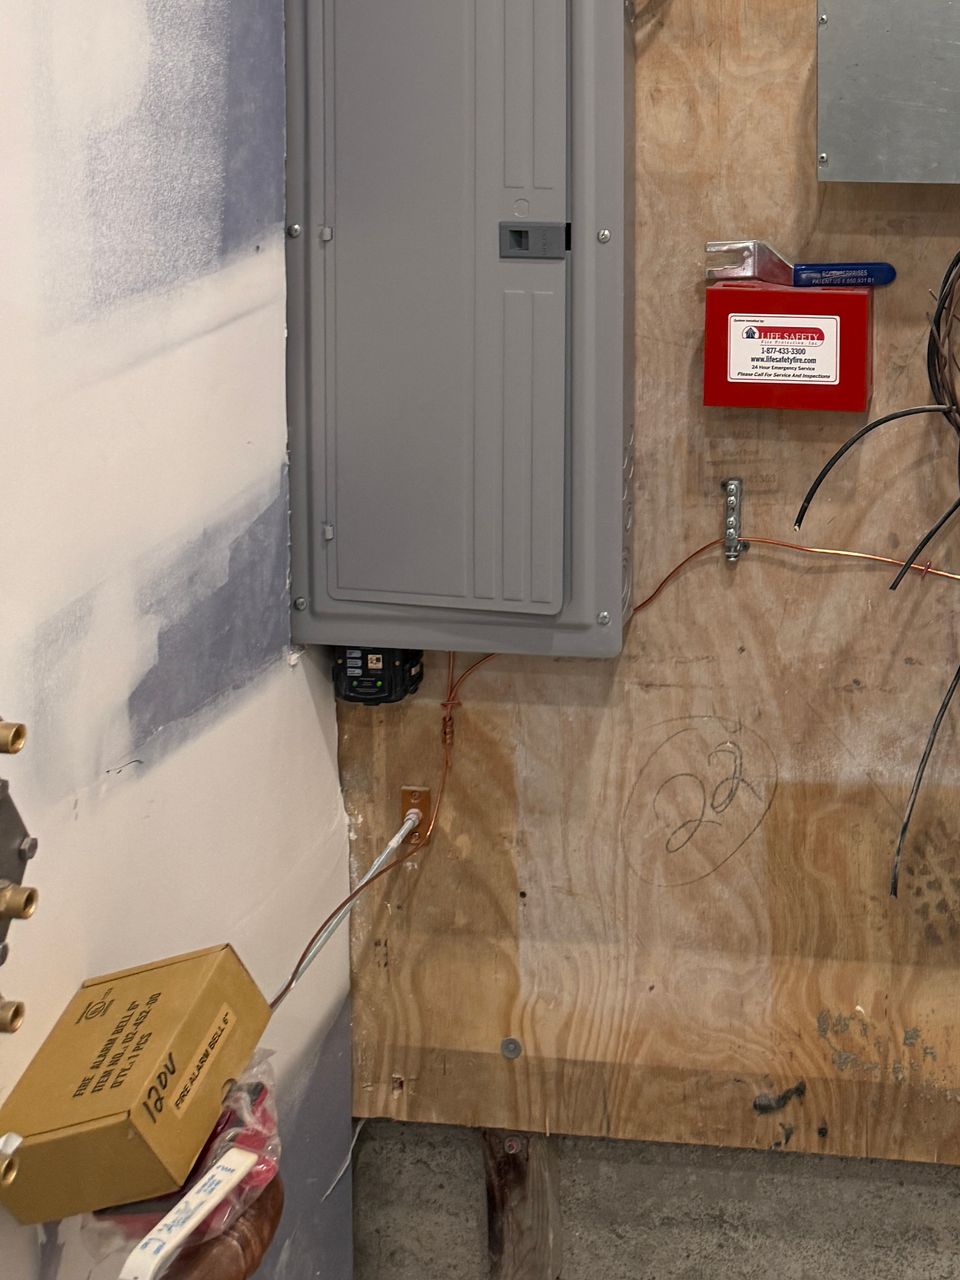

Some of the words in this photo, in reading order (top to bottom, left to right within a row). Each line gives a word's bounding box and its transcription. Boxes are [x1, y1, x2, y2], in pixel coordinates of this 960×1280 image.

[761, 332, 782, 340] LIFE
[783, 333, 820, 341] SAFETY
[750, 356, 817, 365] www.lifesafetyfire.com
[761, 347, 807, 355] 1-877-433-3300
[132, 1032, 153, 1053] PCS
[73, 1074, 95, 1098] FIRE
[90, 1037, 119, 1070] ALARM
[111, 1011, 135, 1036] BELL
[174, 1083, 191, 1110] FIRE
[188, 1049, 211, 1087] ALARM
[207, 1025, 226, 1051] BELL
[91, 1067, 115, 1094] ITEM
